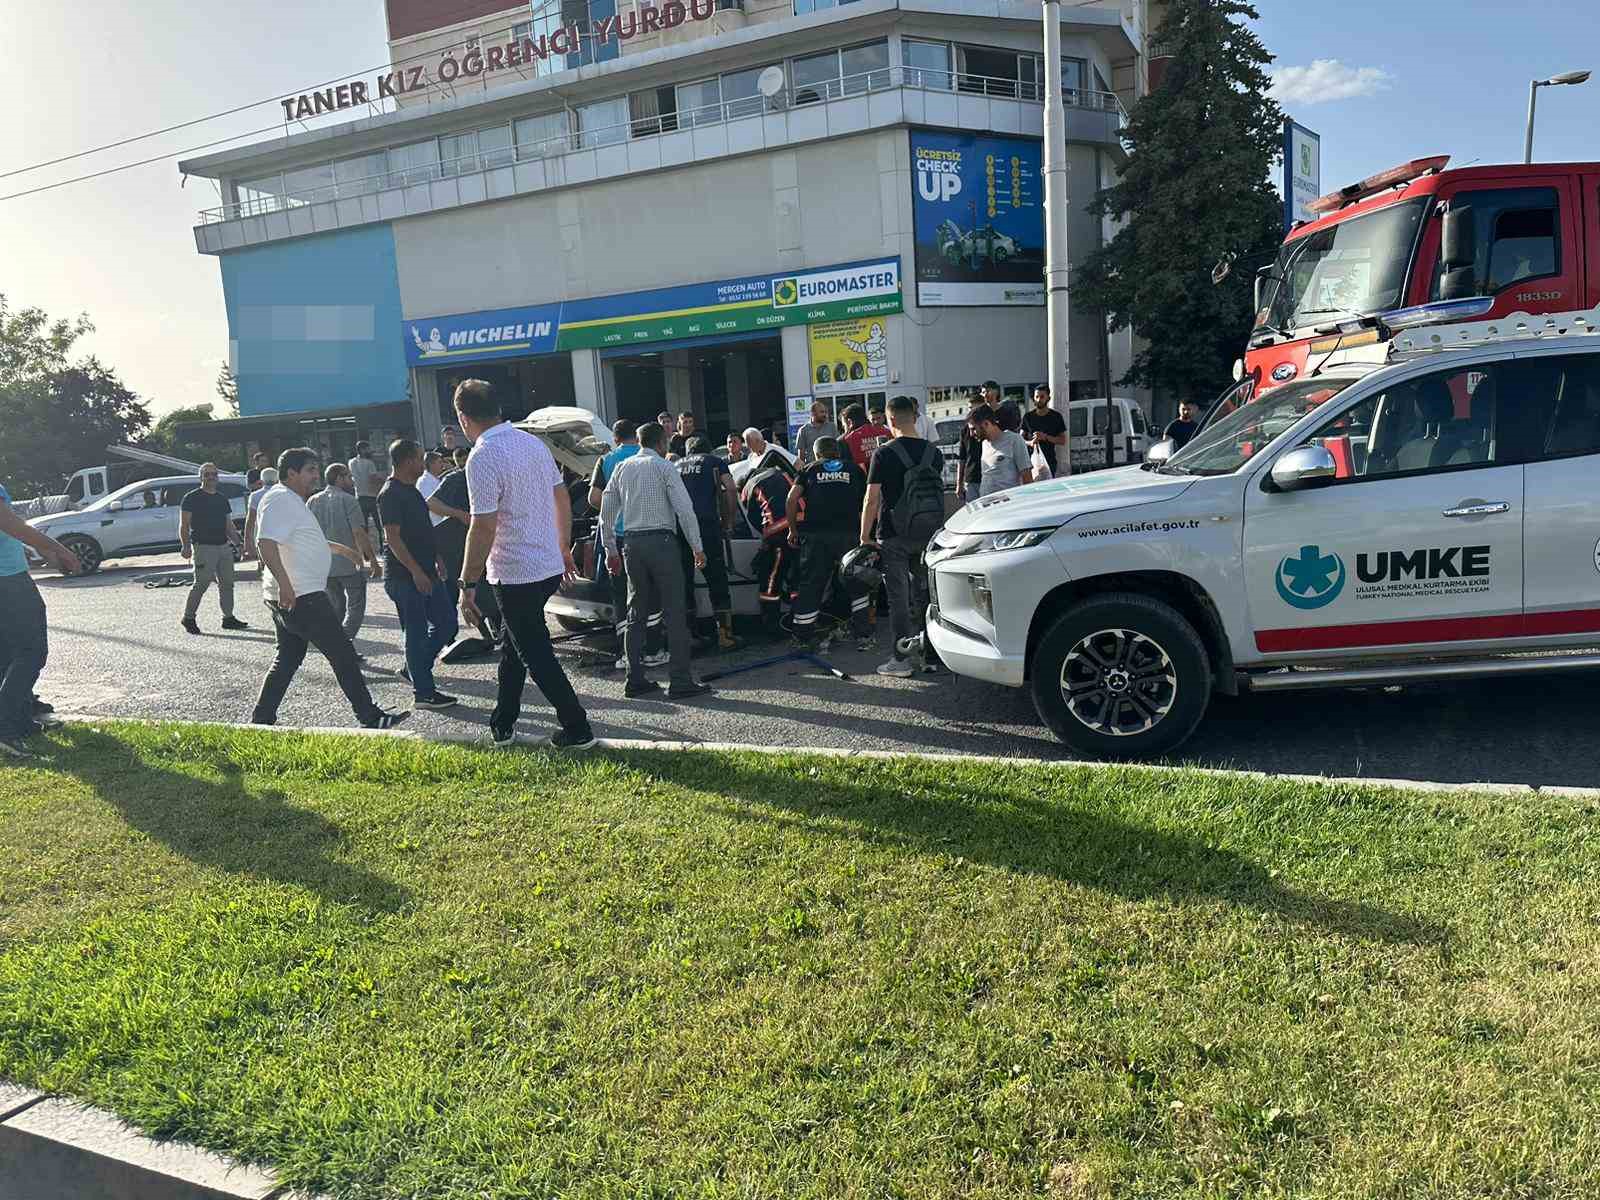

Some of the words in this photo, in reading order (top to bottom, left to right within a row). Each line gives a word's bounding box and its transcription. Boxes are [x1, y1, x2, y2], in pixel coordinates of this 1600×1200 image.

[281, 81, 369, 121] TANER
[377, 65, 427, 98] KIZ
[438, 21, 581, 82] ÖĞRENCİ
[592, 0, 716, 43] YURDU
[915, 146, 962, 161] ÜCRETSİZ
[918, 171, 962, 202] UP
[717, 284, 746, 296] MERGEN
[747, 281, 767, 291] AUTO
[799, 271, 894, 298] EUROMASTER
[448, 321, 552, 346] MICHELIN
[816, 471, 851, 481] UMKE
[1078, 520, 1201, 538] www.acilafet.gov.tr
[1356, 545, 1491, 583] UMKE
[1356, 585, 1386, 593] ULUSAL
[1423, 580, 1468, 589] KURTARMA
